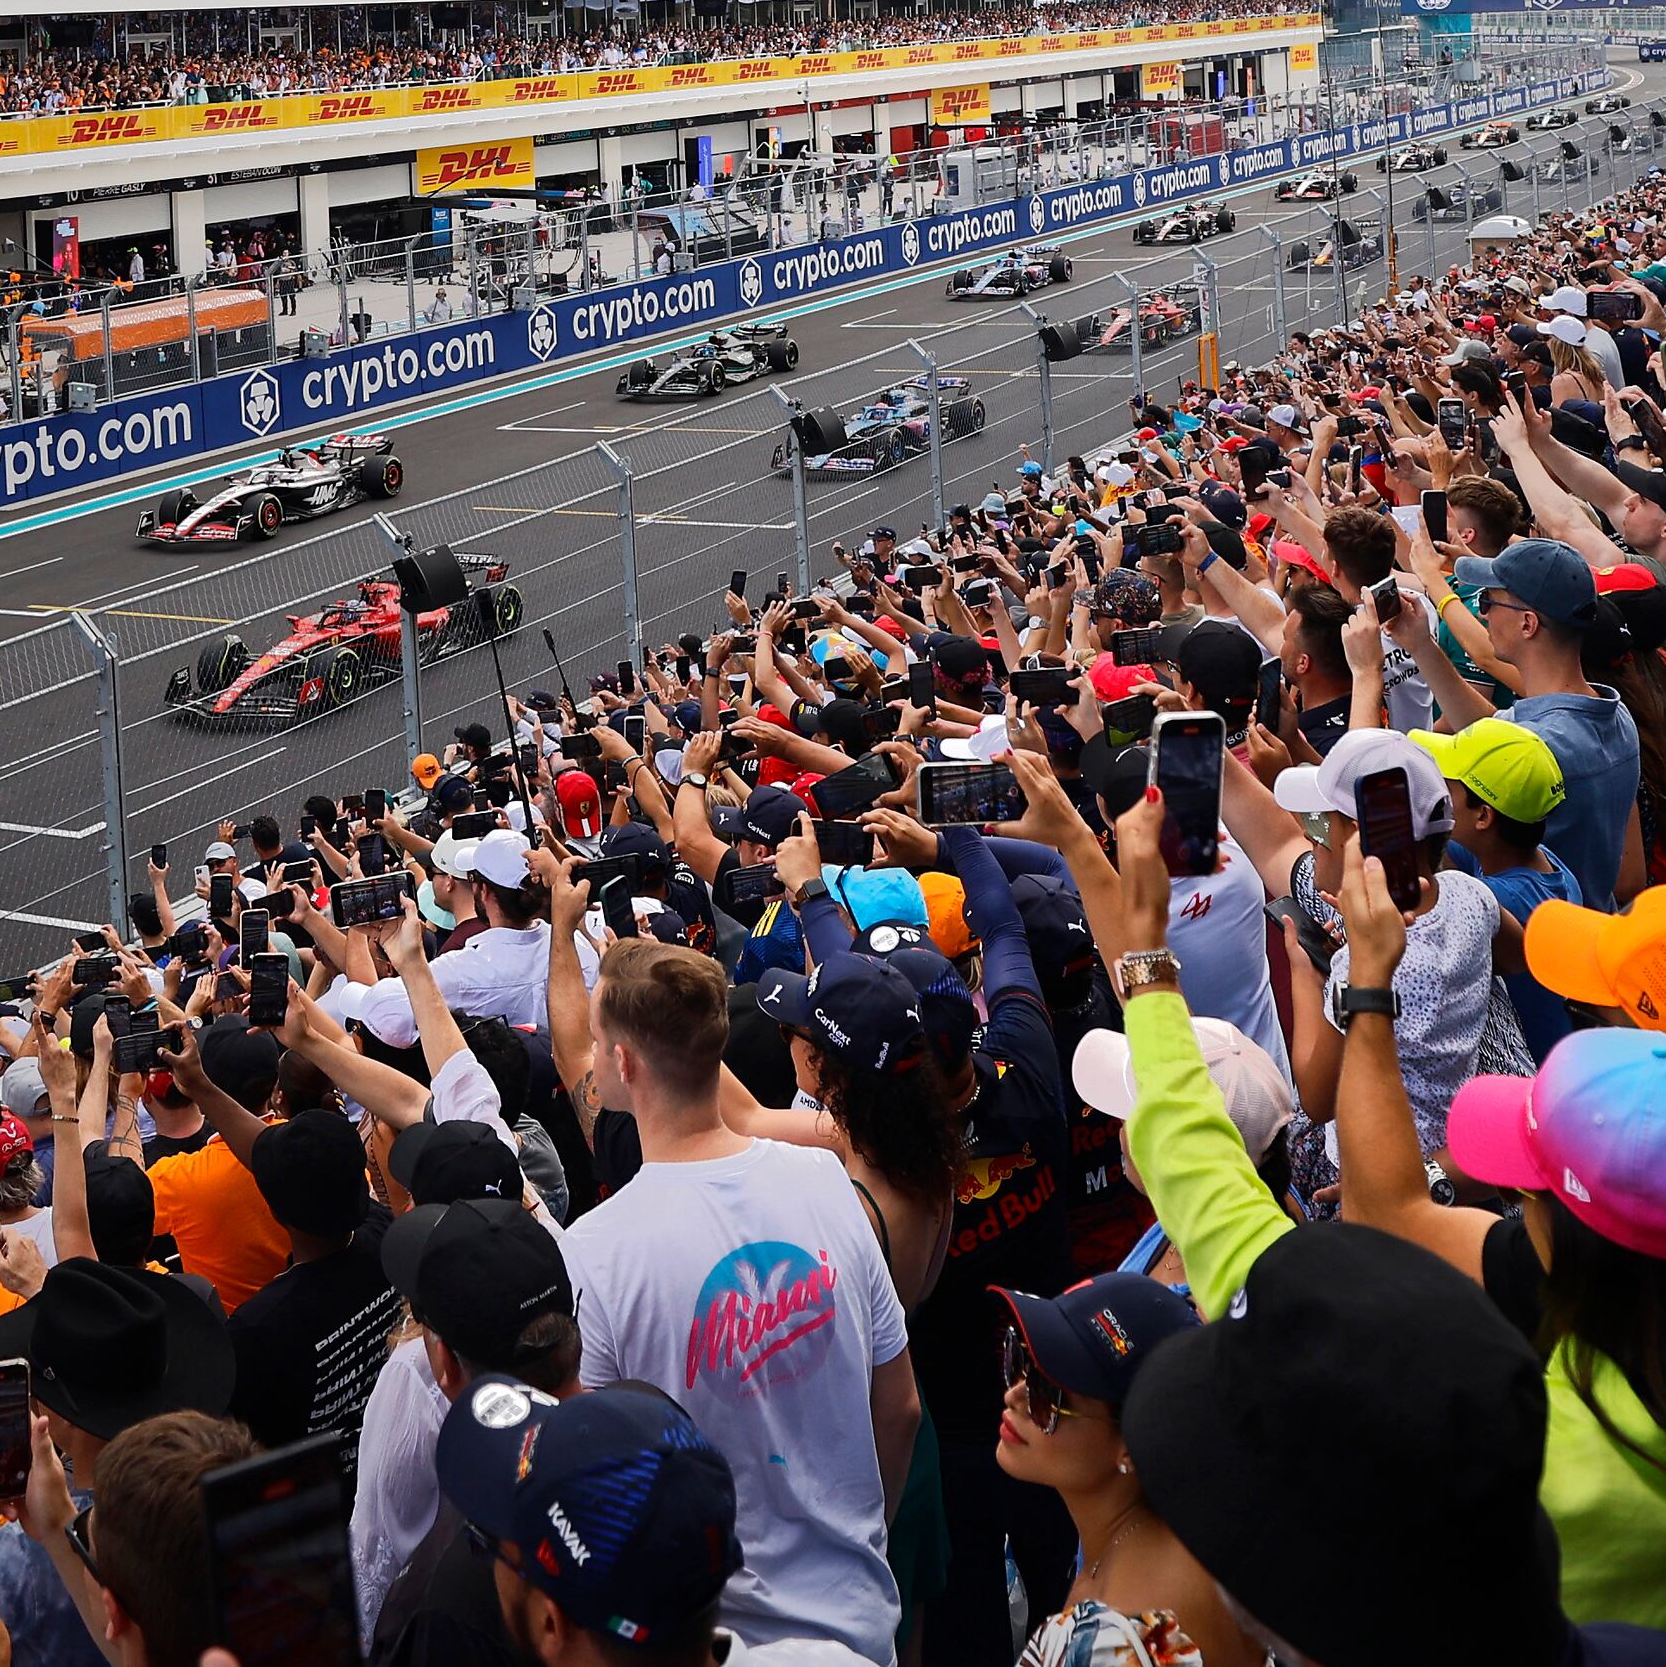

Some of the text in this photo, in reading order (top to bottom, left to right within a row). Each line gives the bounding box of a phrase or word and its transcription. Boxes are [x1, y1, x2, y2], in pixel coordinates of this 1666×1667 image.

[856, 53, 884, 68] DHL
[908, 49, 933, 63] DHL
[956, 44, 980, 59] DHL
[1000, 41, 1023, 54] DHL
[671, 67, 707, 85] DHL
[740, 62, 772, 79] DHL
[800, 57, 831, 74] DHL
[514, 80, 558, 101] DHL
[596, 73, 637, 93] DHL
[320, 96, 376, 120] DHL
[422, 88, 472, 110] DHL
[941, 88, 983, 113] DHL
[1458, 101, 1489, 122] crypto.com
[72, 114, 145, 143] DHL
[203, 105, 265, 131] DHL
[1414, 110, 1446, 134] crypto.com
[437, 146, 517, 184] DHL
[1233, 146, 1284, 177] crypto.com
[1150, 163, 1211, 197] crypto.com
[1050, 184, 1121, 222] crypto.com
[928, 209, 1015, 252] crypto.com
[773, 238, 883, 291] crypto.com
[572, 279, 716, 340] crypto.com
[302, 327, 495, 410] crypto.com
[1467, 772, 1499, 802] cognizant
[746, 820, 771, 841] CarNext
[1180, 891, 1213, 922] 44
[814, 1007, 851, 1046] CarNext
[998, 1164, 1056, 1230] Bull
[519, 1285, 559, 1311] ASTON MARTIN
[686, 1248, 836, 1391] Miami
[1102, 1308, 1135, 1352] ORACLE
[547, 1500, 591, 1567] KAVAK
